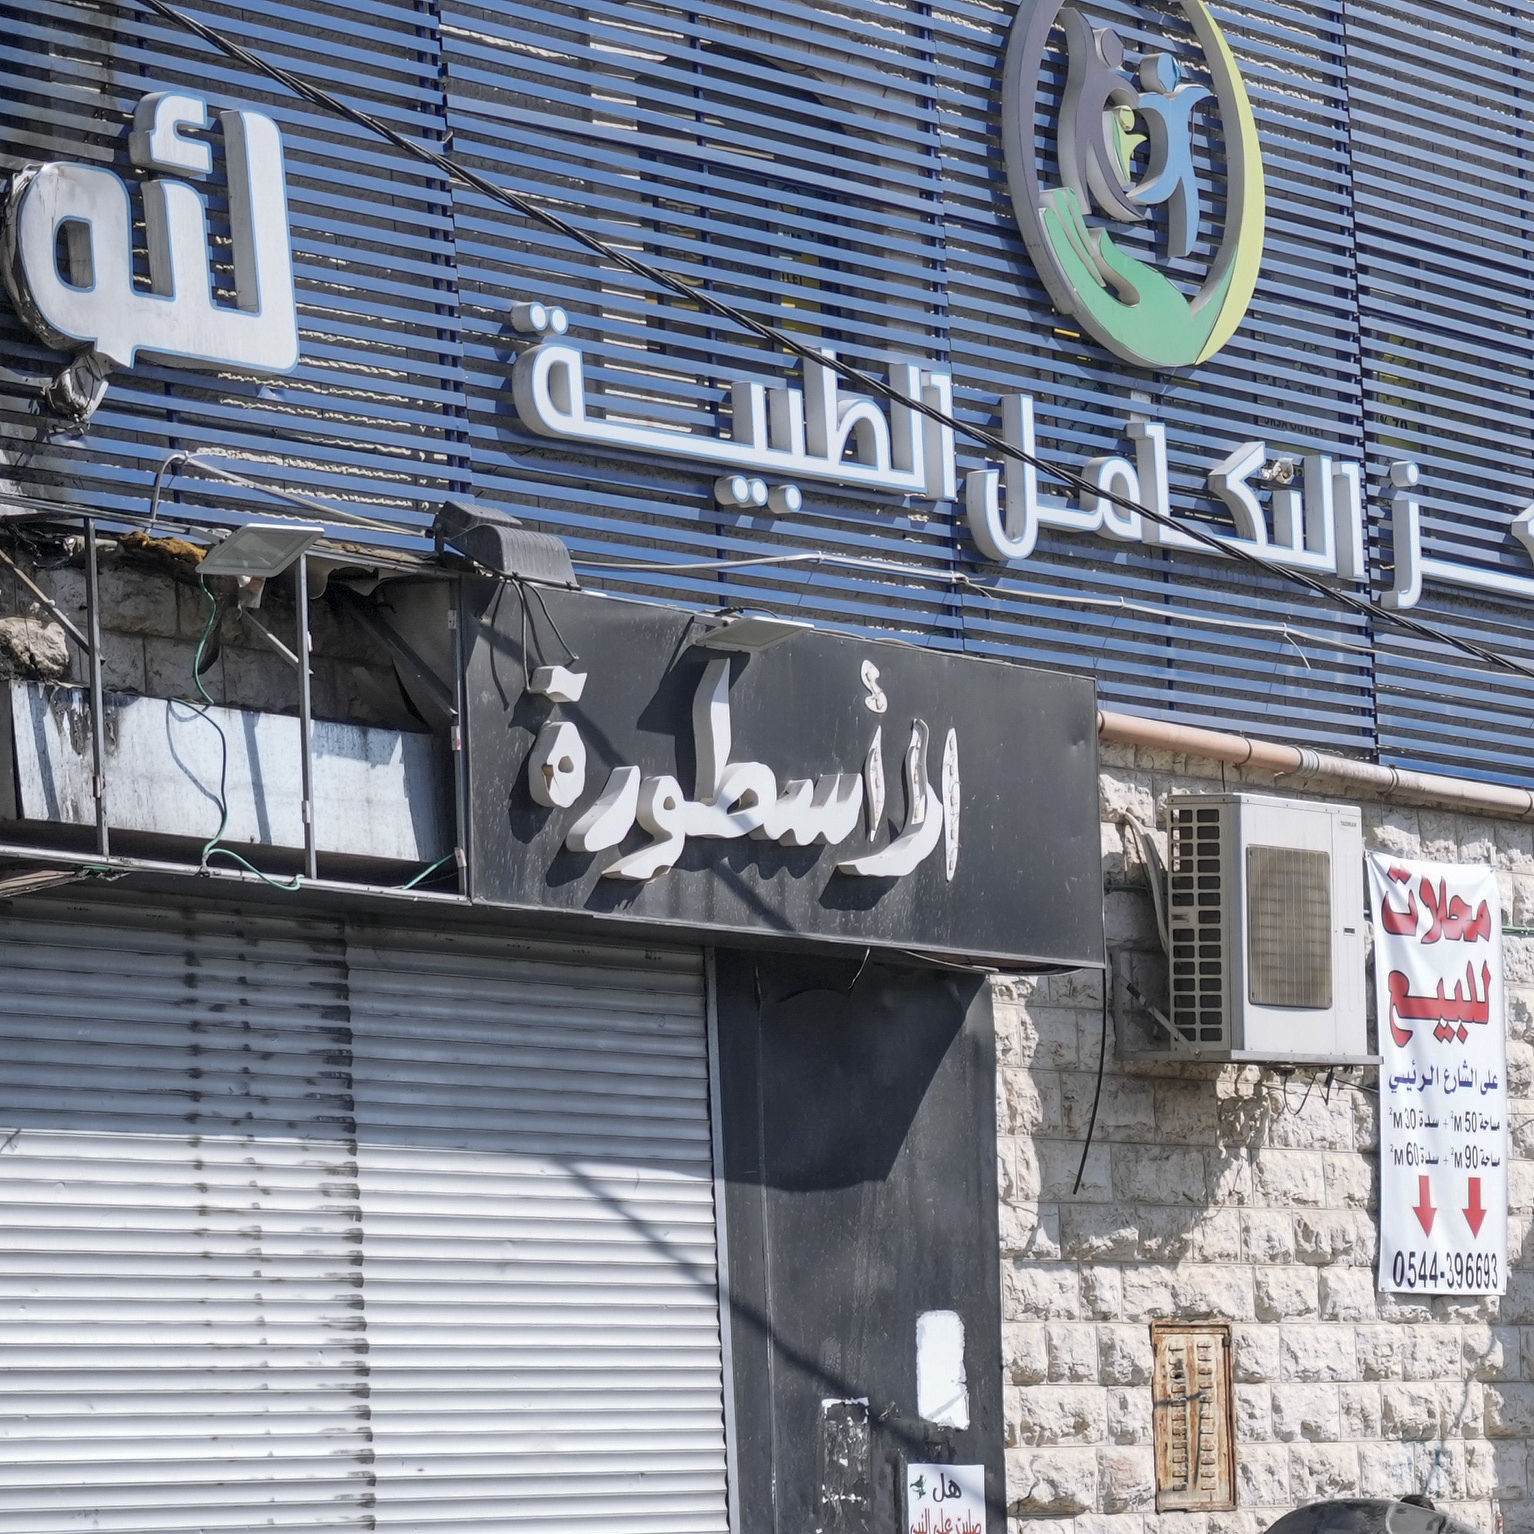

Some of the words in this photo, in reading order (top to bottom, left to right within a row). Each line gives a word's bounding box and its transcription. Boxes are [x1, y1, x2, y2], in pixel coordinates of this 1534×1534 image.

[510, 301, 958, 515] الطبية
[966, 394, 1365, 580] التكامل
[1381, 865, 1492, 944] محلات
[1387, 959, 1492, 1048] للبيع
[1388, 1059, 1439, 1094] الرئيسي
[1443, 1059, 1477, 1095] الشارع
[1480, 1067, 1498, 1095] على
[1478, 1112, 1500, 1132] ساحة
[1479, 1148, 1501, 1167] ساحة
[1391, 1249, 1499, 1289] 0544-396693
[933, 1472, 962, 1503] هل
